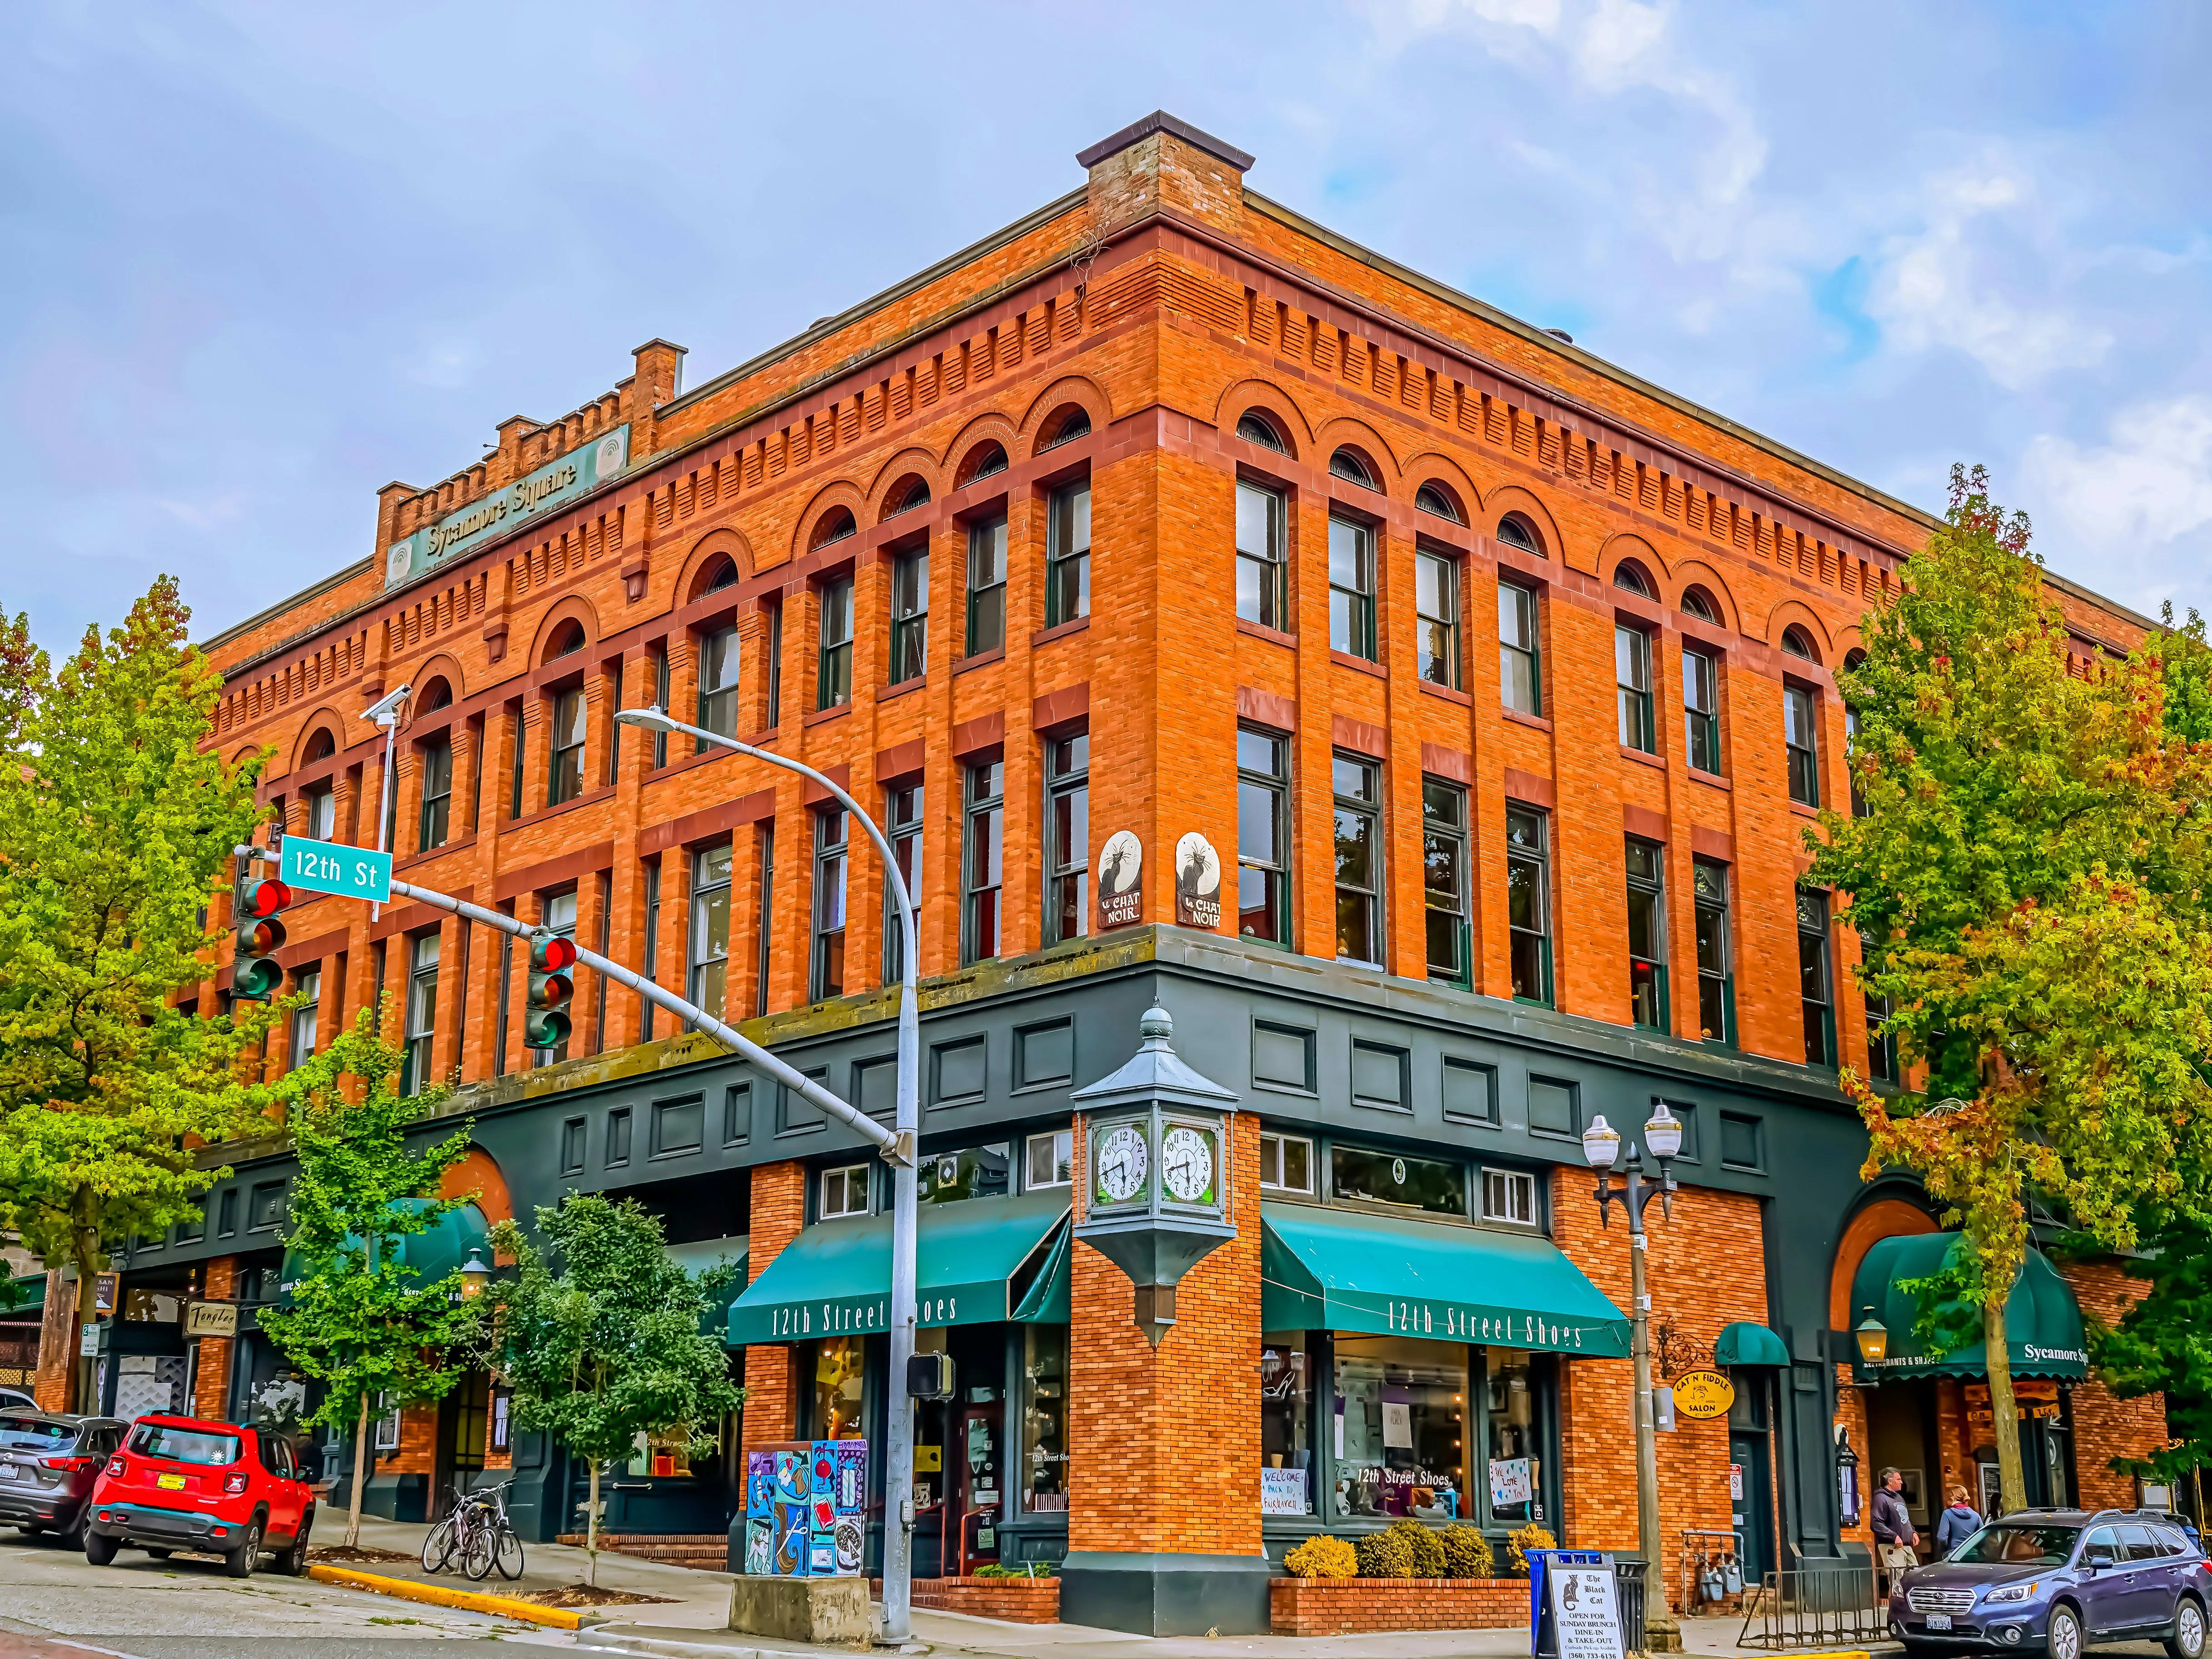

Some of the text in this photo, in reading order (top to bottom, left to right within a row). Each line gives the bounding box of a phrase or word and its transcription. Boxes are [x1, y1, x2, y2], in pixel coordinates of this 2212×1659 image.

[427, 463, 577, 557] Sycamore Square
[296, 851, 377, 888] 12th St
[1113, 892, 1141, 909] CHAT
[1107, 907, 1140, 924] NOIR
[1192, 910, 1220, 928] NOIR
[1111, 1136, 1117, 1146] 11
[1120, 1131, 1128, 1141] 12
[1174, 1133, 1179, 1144] 11
[1182, 1131, 1190, 1141] 12
[1105, 1146, 1111, 1156] 10
[1137, 1142, 1143, 1153] 2
[1167, 1141, 1174, 1152] 10
[1201, 1147, 1205, 1157] 2
[1102, 1161, 1106, 1171] 9
[1139, 1156, 1145, 1167] 3
[1164, 1156, 1169, 1166] 9
[1203, 1161, 1208, 1171] 3
[1136, 1170, 1142, 1181] 4
[1167, 1171, 1172, 1181] 8
[1200, 1175, 1206, 1185] 4
[1111, 1184, 1115, 1194] 7
[1120, 1186, 1125, 1196] 6
[1130, 1181, 1135, 1192] 5
[1174, 1182, 1180, 1192] 7
[1184, 1186, 1189, 1196] 6
[1194, 1184, 1199, 1194] 5
[773, 1297, 955, 1336] 12th Street oes
[1388, 1301, 1582, 1347] 12th Street Shoes
[84, 1327, 88, 1335] 2
[2025, 1344, 2078, 1362] Sycamore
[1908, 1357, 1913, 1365] &
[1677, 1377, 1689, 1392] CAT
[1703, 1374, 1729, 1392] FIDDLE
[1495, 1466, 1503, 1477] WE
[1265, 1472, 1300, 1482] WELCOME
[1358, 1468, 1449, 1486] 12th Street Shoes
[1502, 1475, 1518, 1487] LOVE
[1268, 1485, 1293, 1494] BACK TO
[1584, 1585, 1606, 1594] Black
